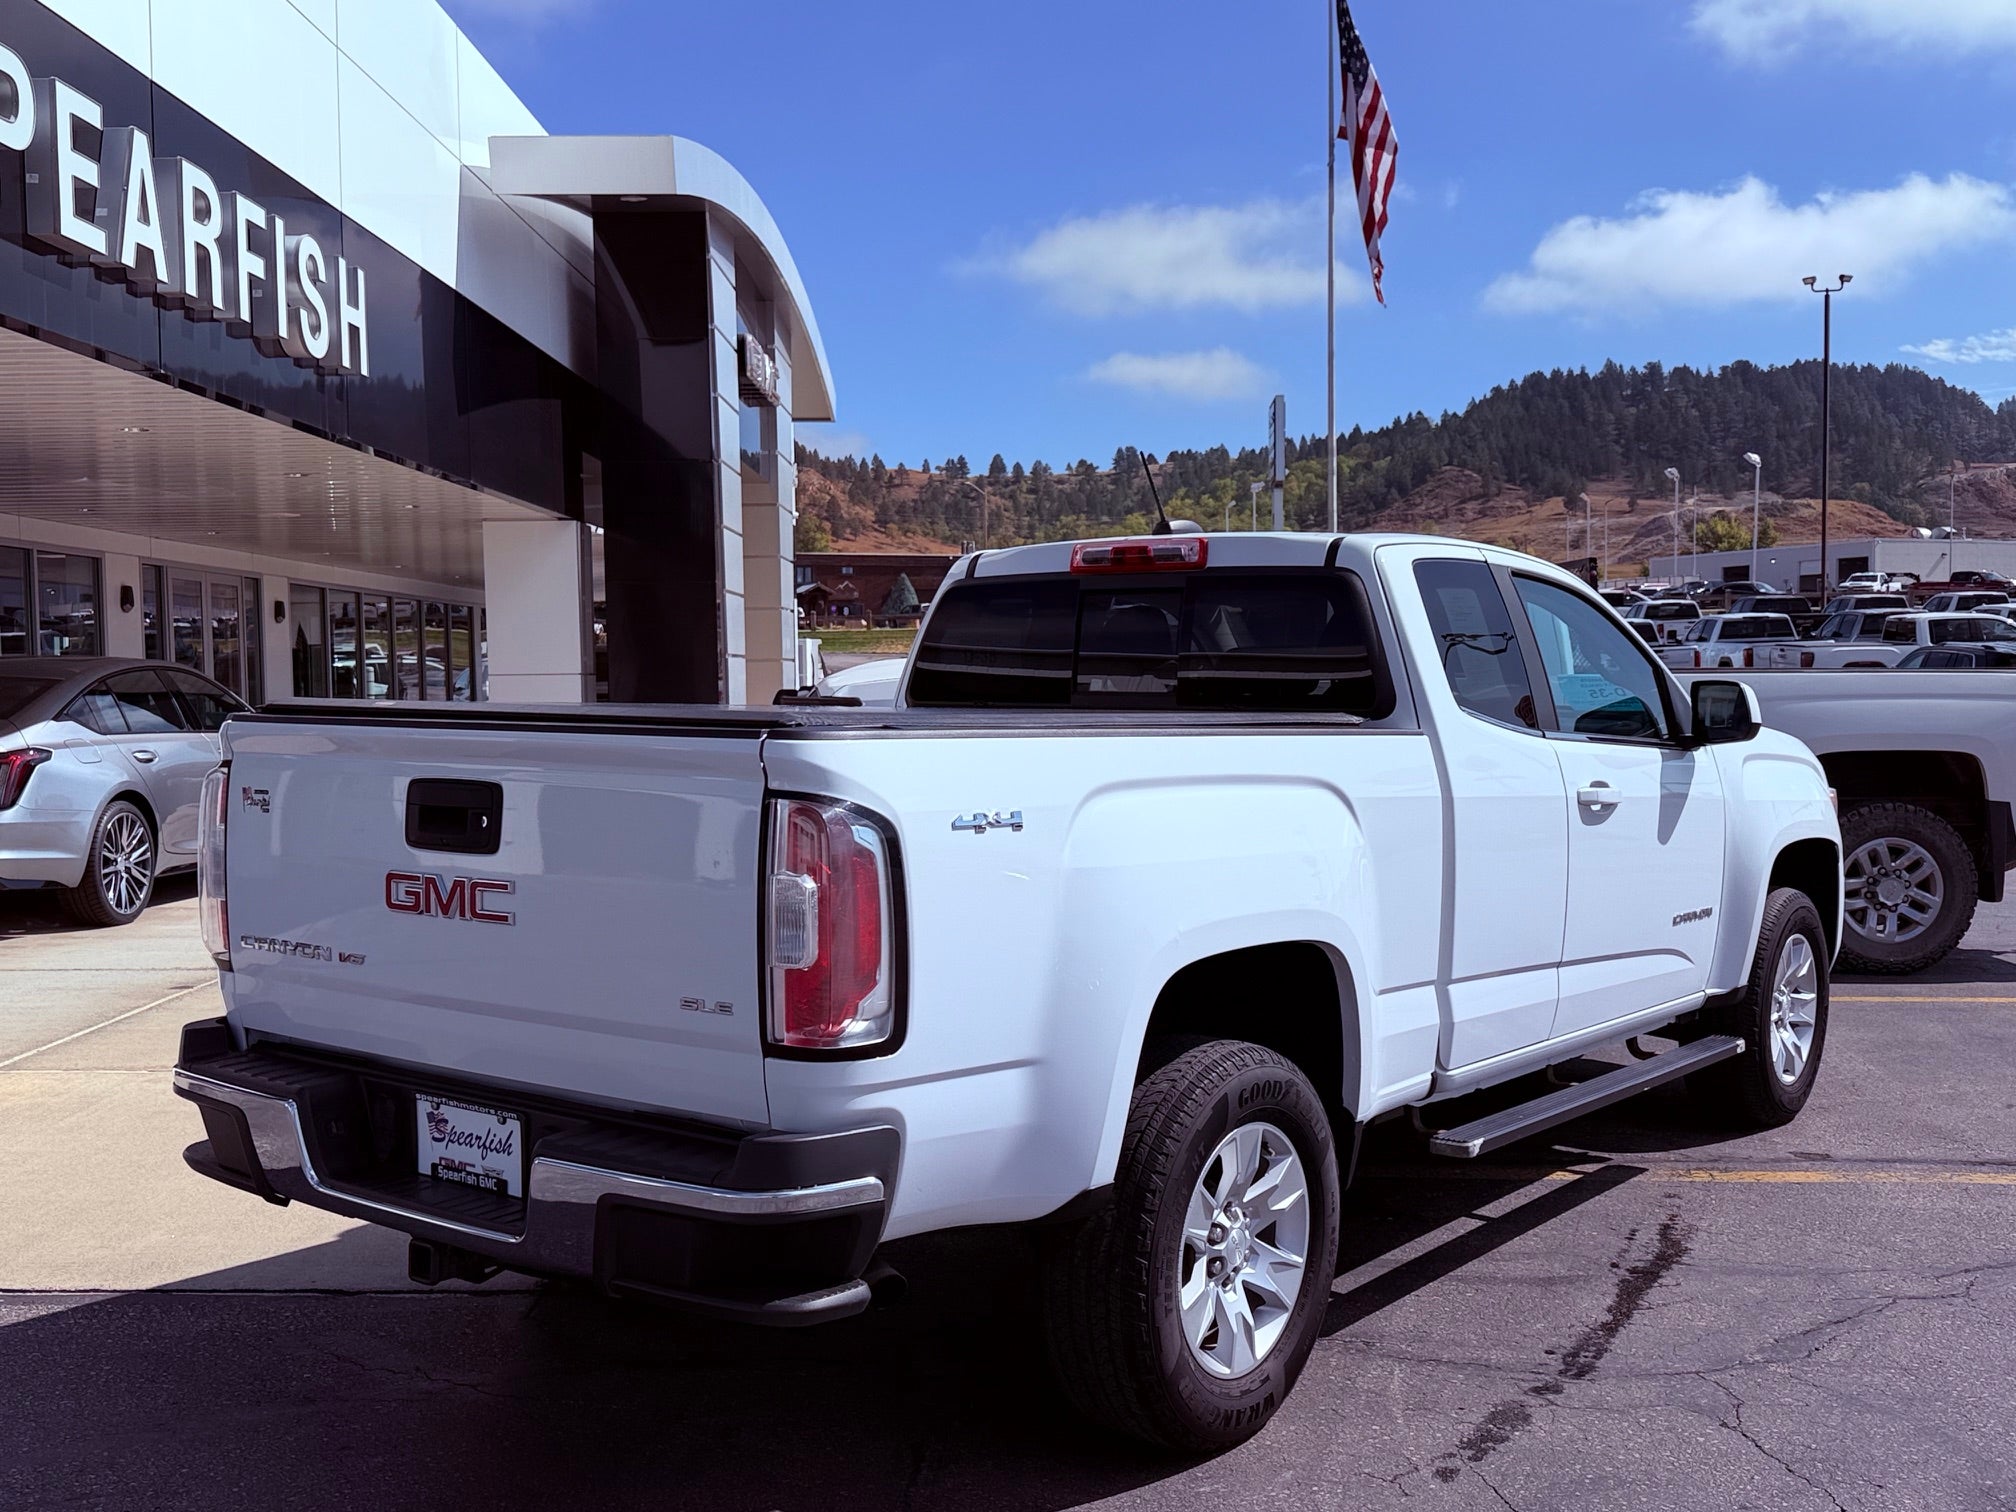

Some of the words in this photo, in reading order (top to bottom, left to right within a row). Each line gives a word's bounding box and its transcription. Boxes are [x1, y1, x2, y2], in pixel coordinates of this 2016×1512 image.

[385, 869, 515, 926] GMC
[240, 935, 333, 962] CANYON
[338, 951, 367, 966] V6
[680, 996, 734, 1016] SLE
[416, 1093, 518, 1120] spearfishmotors.com
[430, 1116, 514, 1161] Spearfish
[437, 1166, 478, 1186] Spearfish
[479, 1176, 498, 1191] GMC
